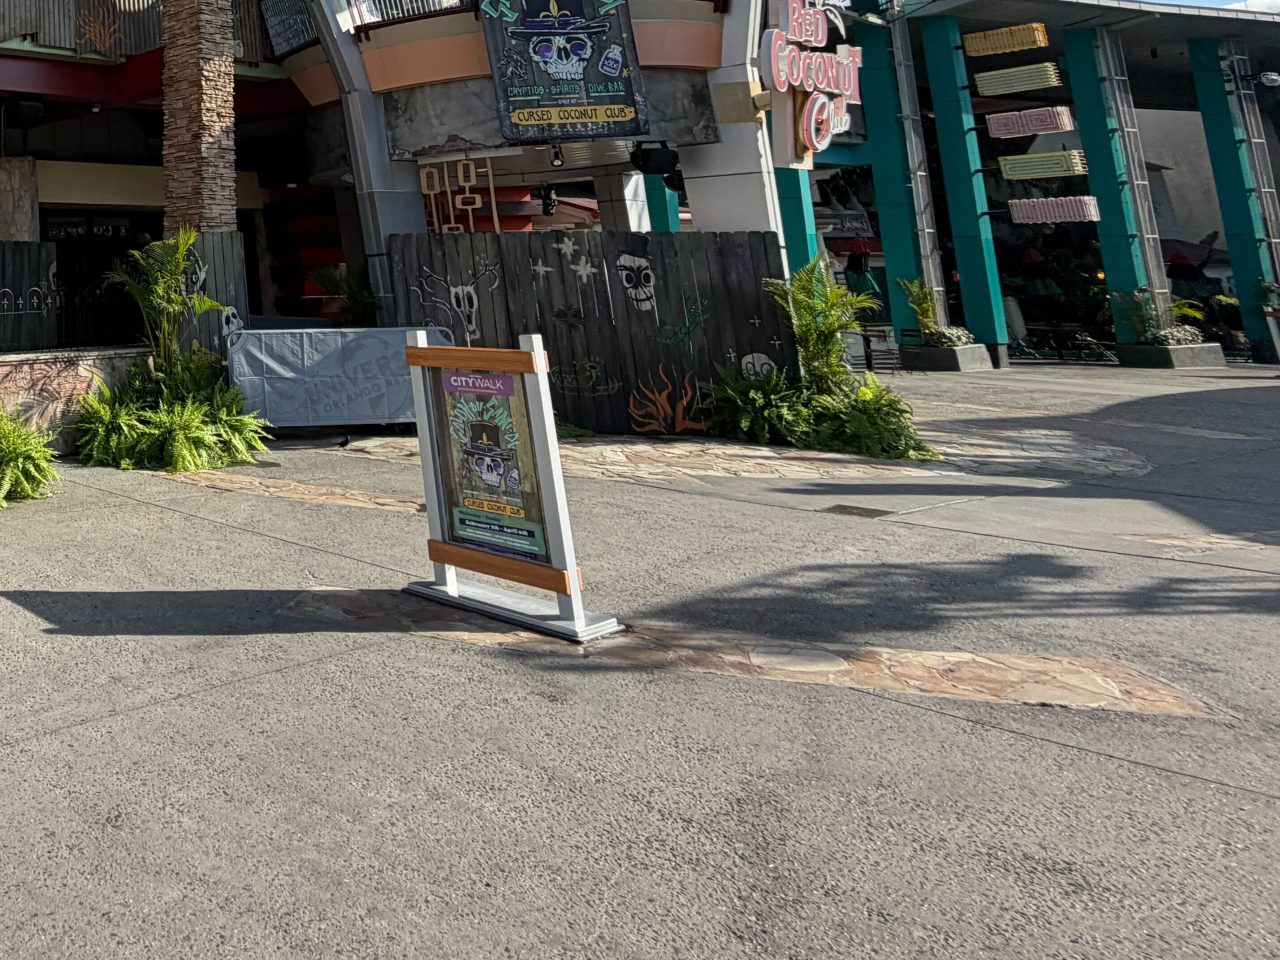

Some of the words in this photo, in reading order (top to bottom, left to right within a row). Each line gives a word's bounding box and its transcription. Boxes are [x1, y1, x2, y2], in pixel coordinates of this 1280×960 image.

[763, 29, 863, 105] COCONUT
[507, 85, 545, 97] CRYPTIDS
[551, 84, 581, 94] SPIRITS
[517, 110, 552, 122] CURSED
[557, 108, 598, 120] COCONUT
[605, 106, 627, 119] CLUB
[804, 91, 851, 152] Club
[450, 376, 504, 390] CITYWALK
